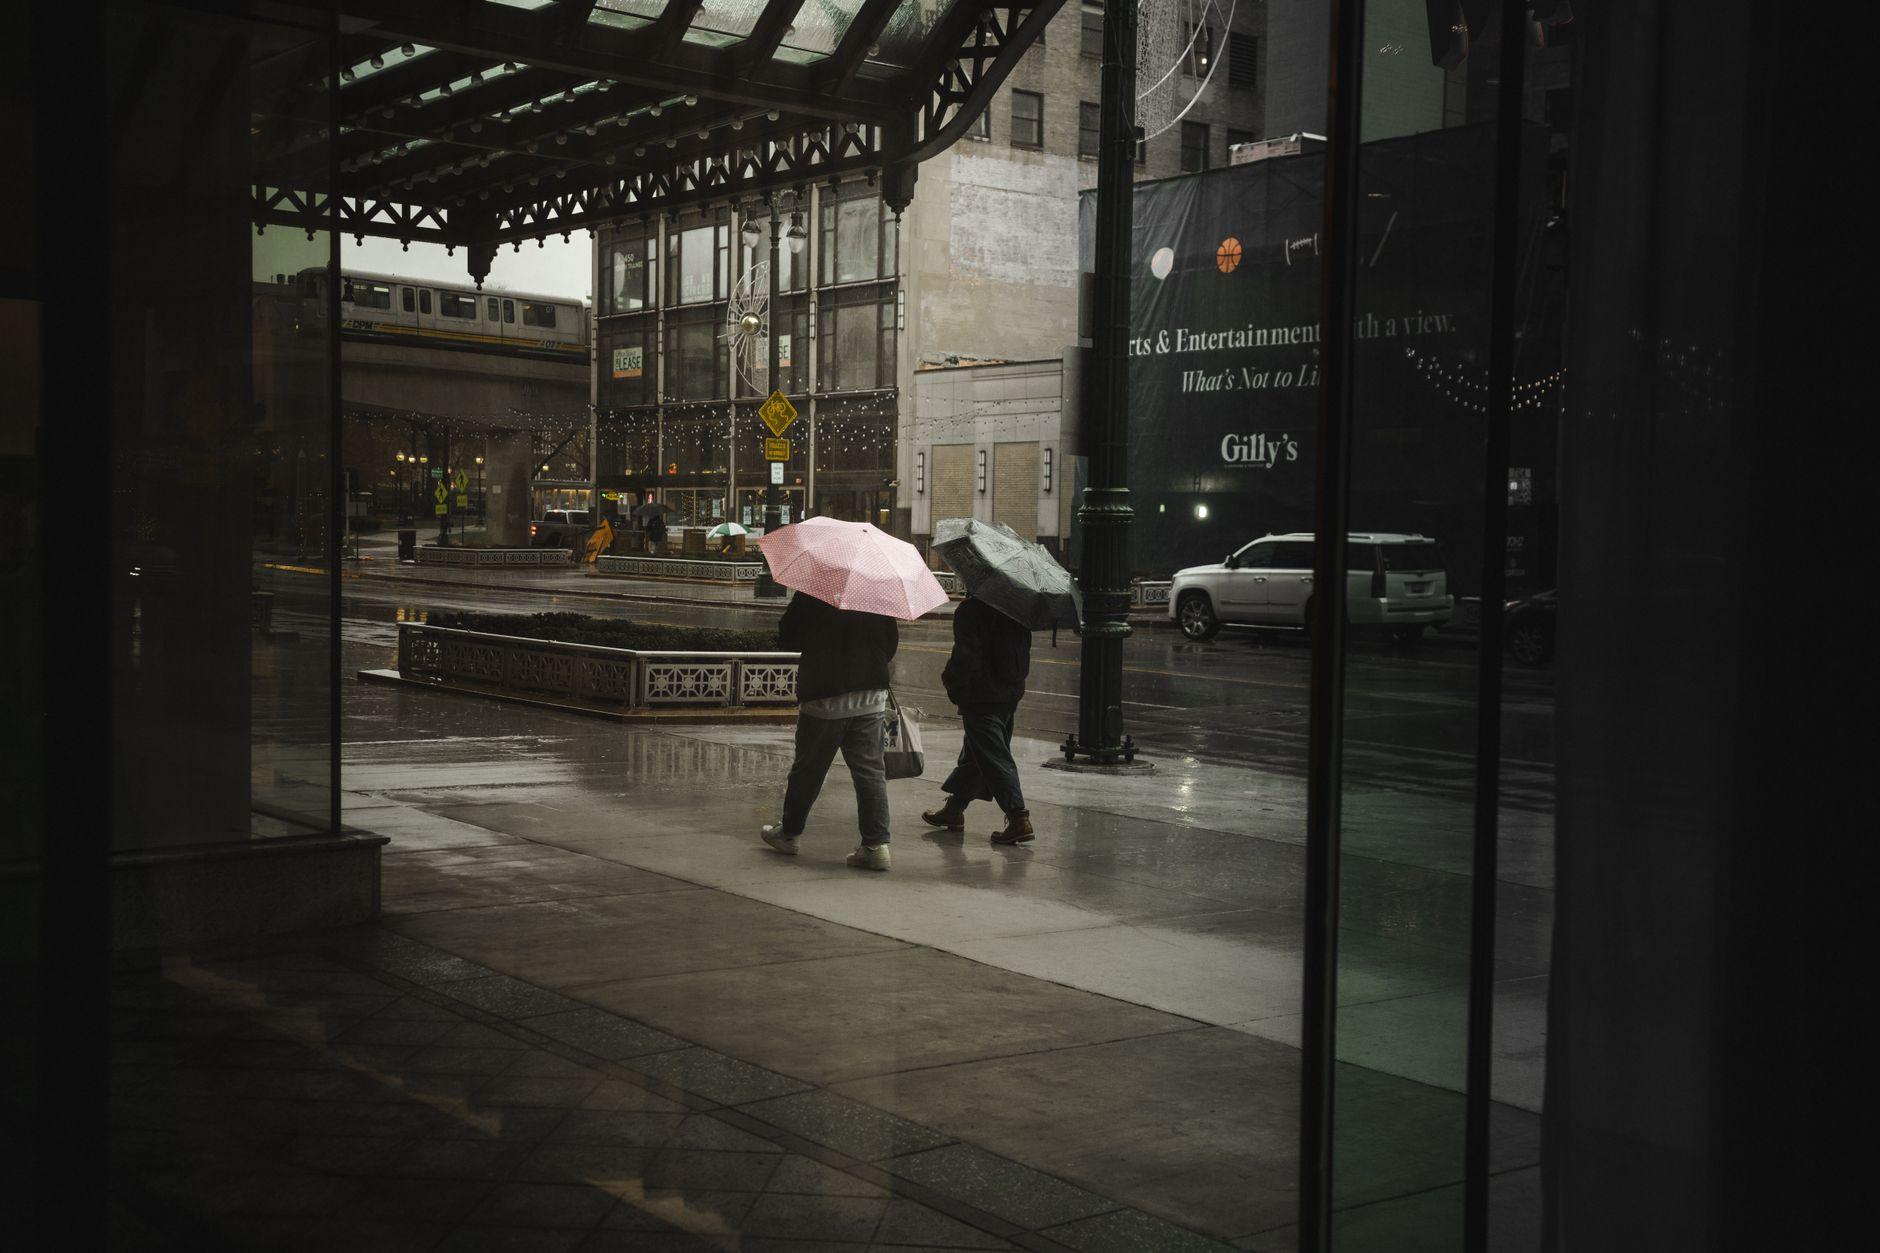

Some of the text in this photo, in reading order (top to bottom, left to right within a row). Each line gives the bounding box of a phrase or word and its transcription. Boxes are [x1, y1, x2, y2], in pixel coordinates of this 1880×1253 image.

[352, 320, 373, 330] DPM
[1129, 309, 1456, 356] rts & Entertainment ith a view.
[618, 356, 641, 371] LEASE
[1182, 364, 1320, 393] What's Not to Li
[1221, 433, 1298, 469] Gilly's
